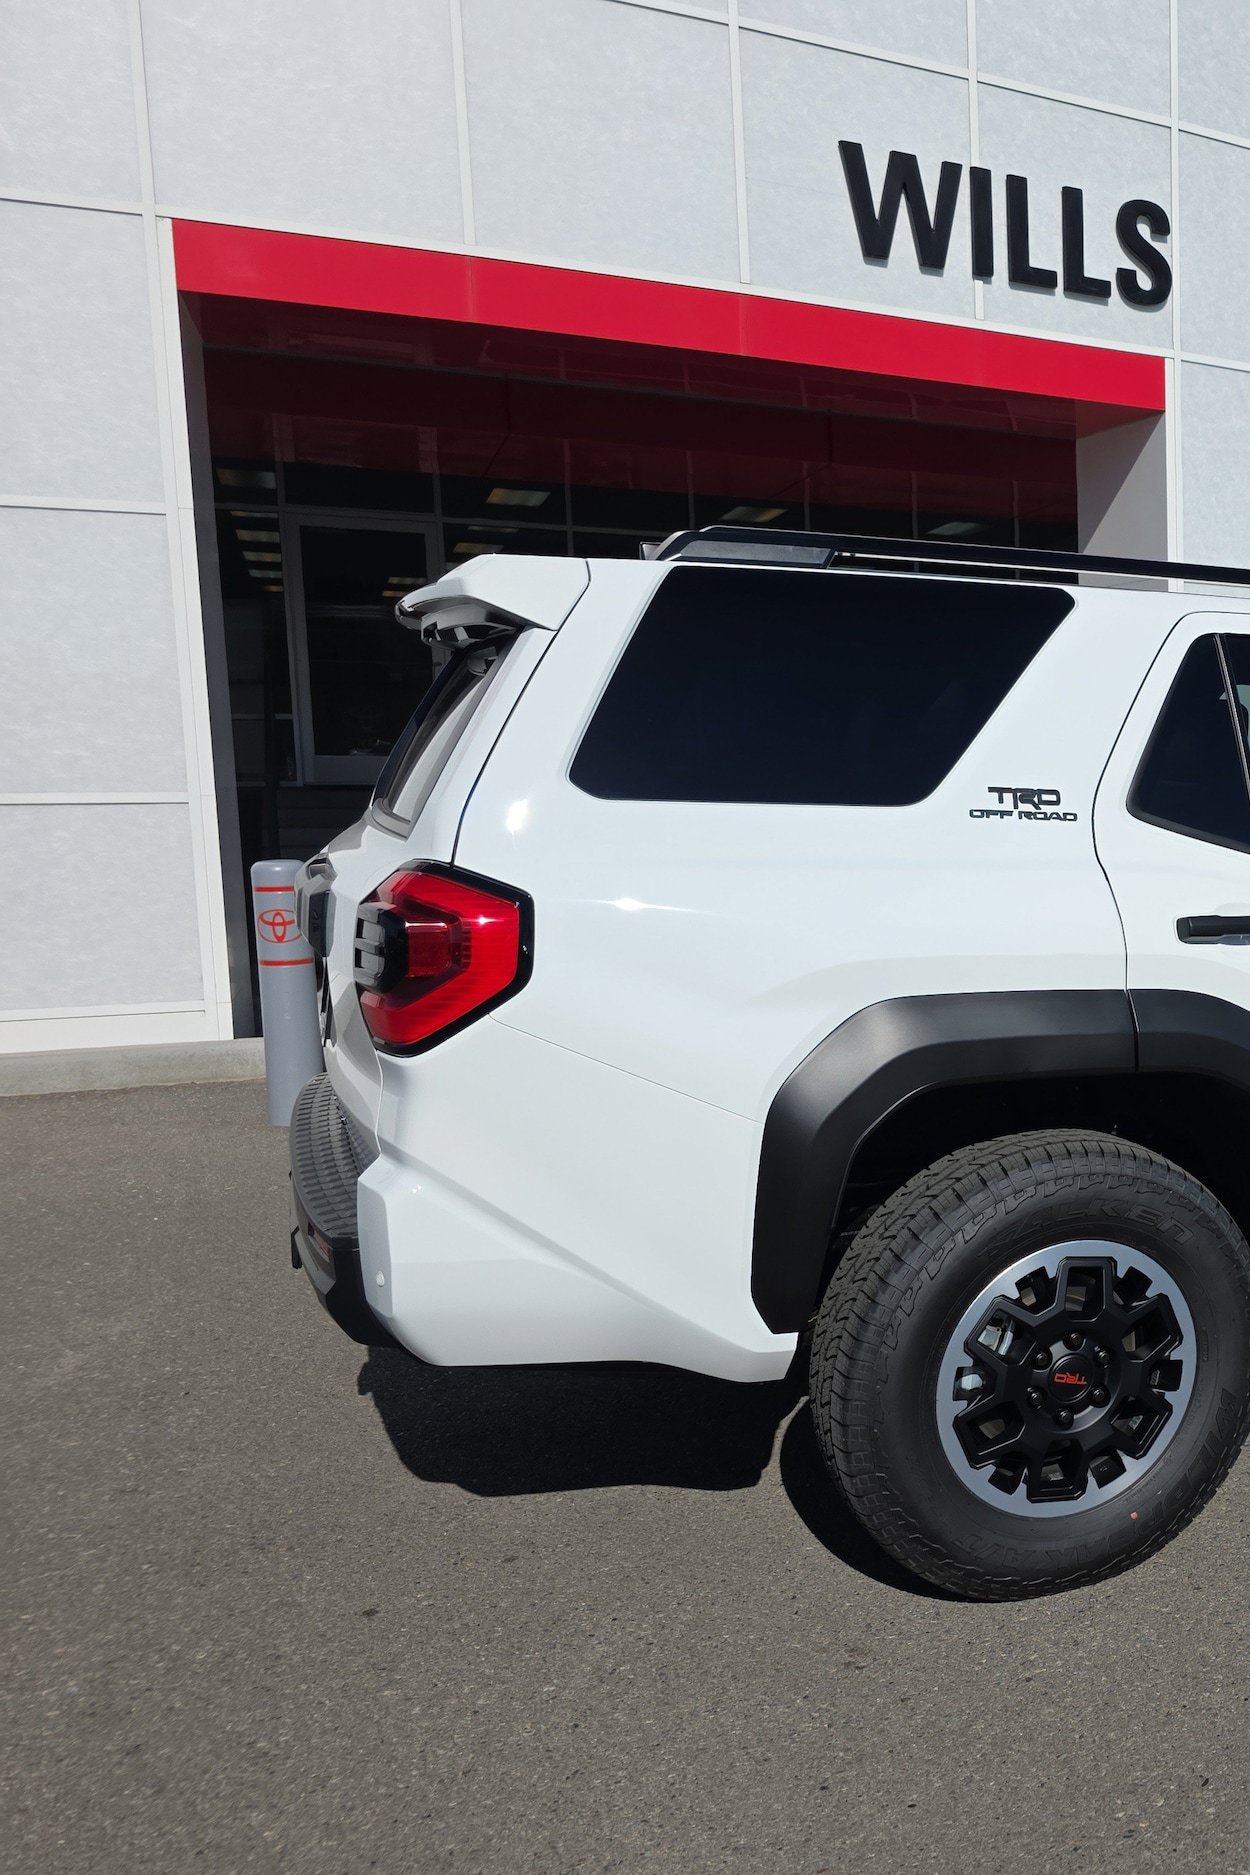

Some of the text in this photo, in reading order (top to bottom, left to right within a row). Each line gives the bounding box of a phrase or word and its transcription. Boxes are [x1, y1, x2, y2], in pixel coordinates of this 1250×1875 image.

[838, 140, 1173, 306] WILLS
[987, 786, 1061, 811] TRD
[969, 809, 1078, 822] OFF ROAD
[1053, 1371, 1088, 1385] TRD
